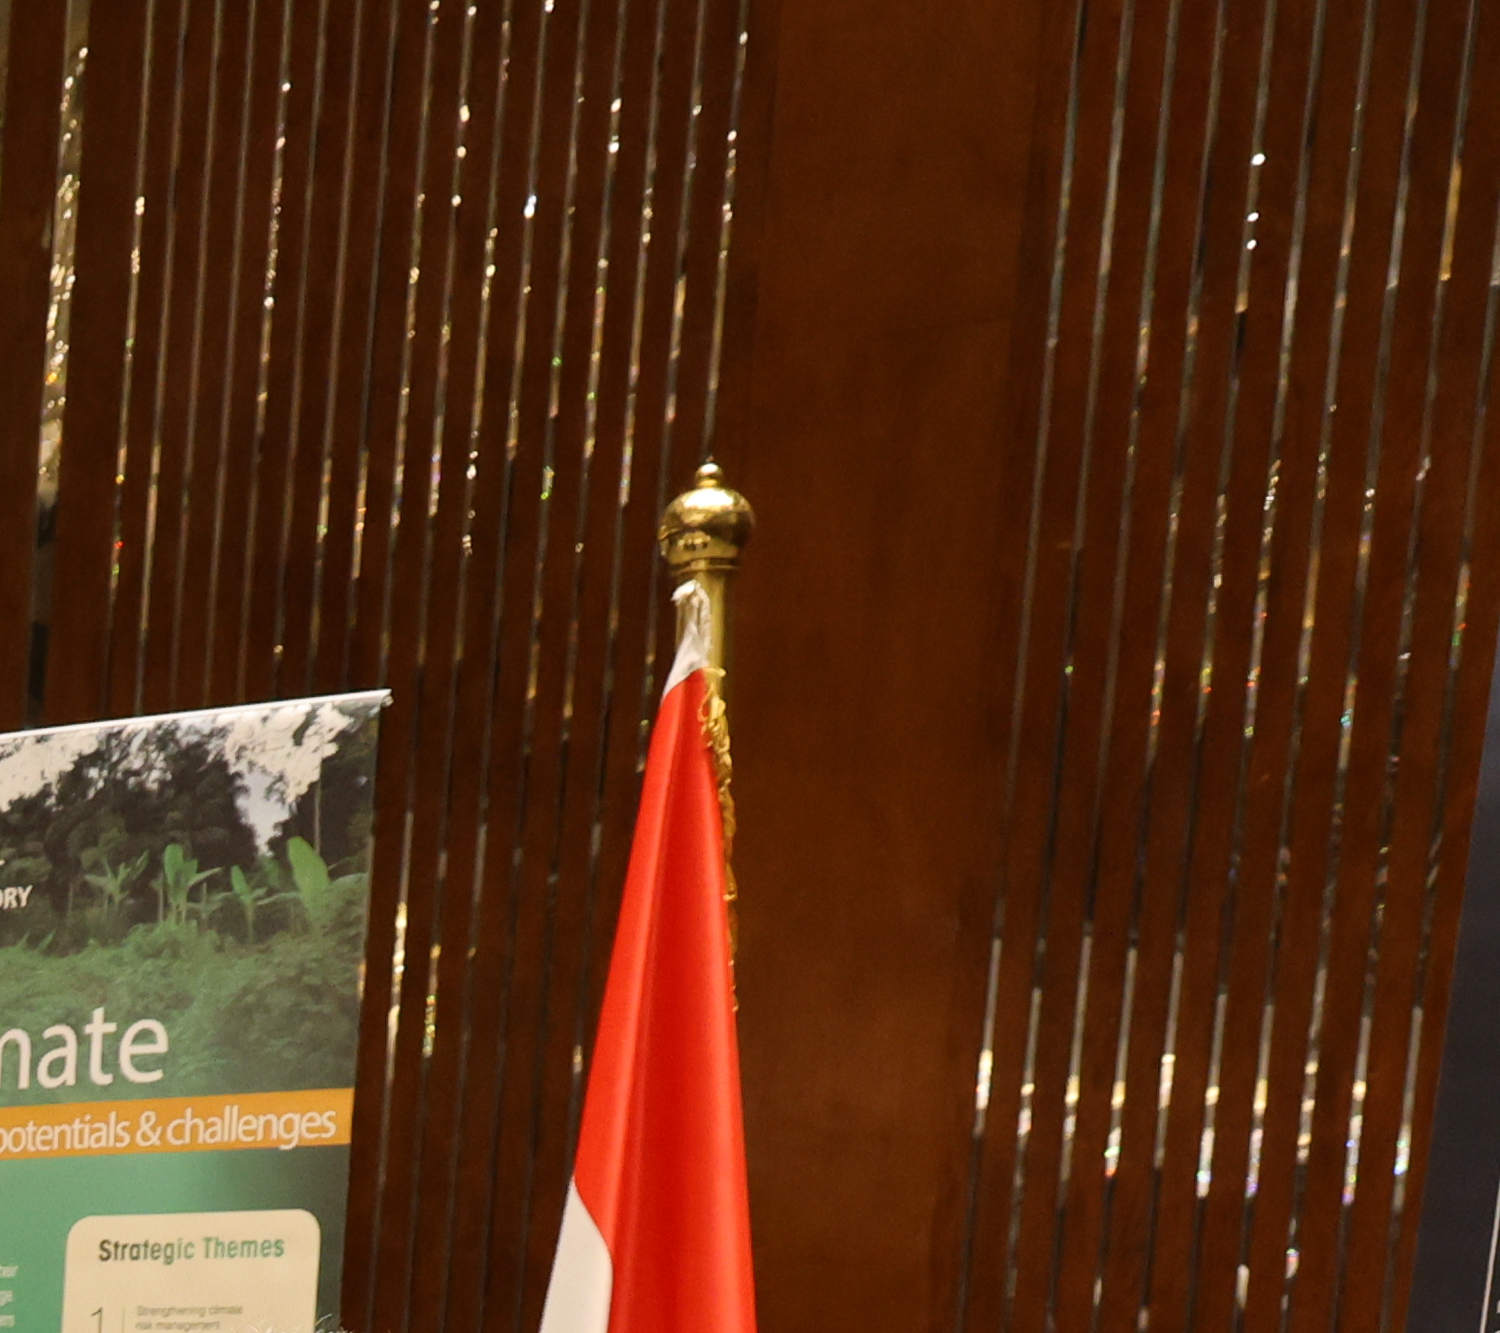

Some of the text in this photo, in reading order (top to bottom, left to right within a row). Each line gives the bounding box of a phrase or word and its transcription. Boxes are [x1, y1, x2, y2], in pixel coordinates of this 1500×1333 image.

[136, 1111, 161, 1147] &
[166, 1105, 337, 1151] challenges
[98, 1237, 284, 1266] Strategic Themes
